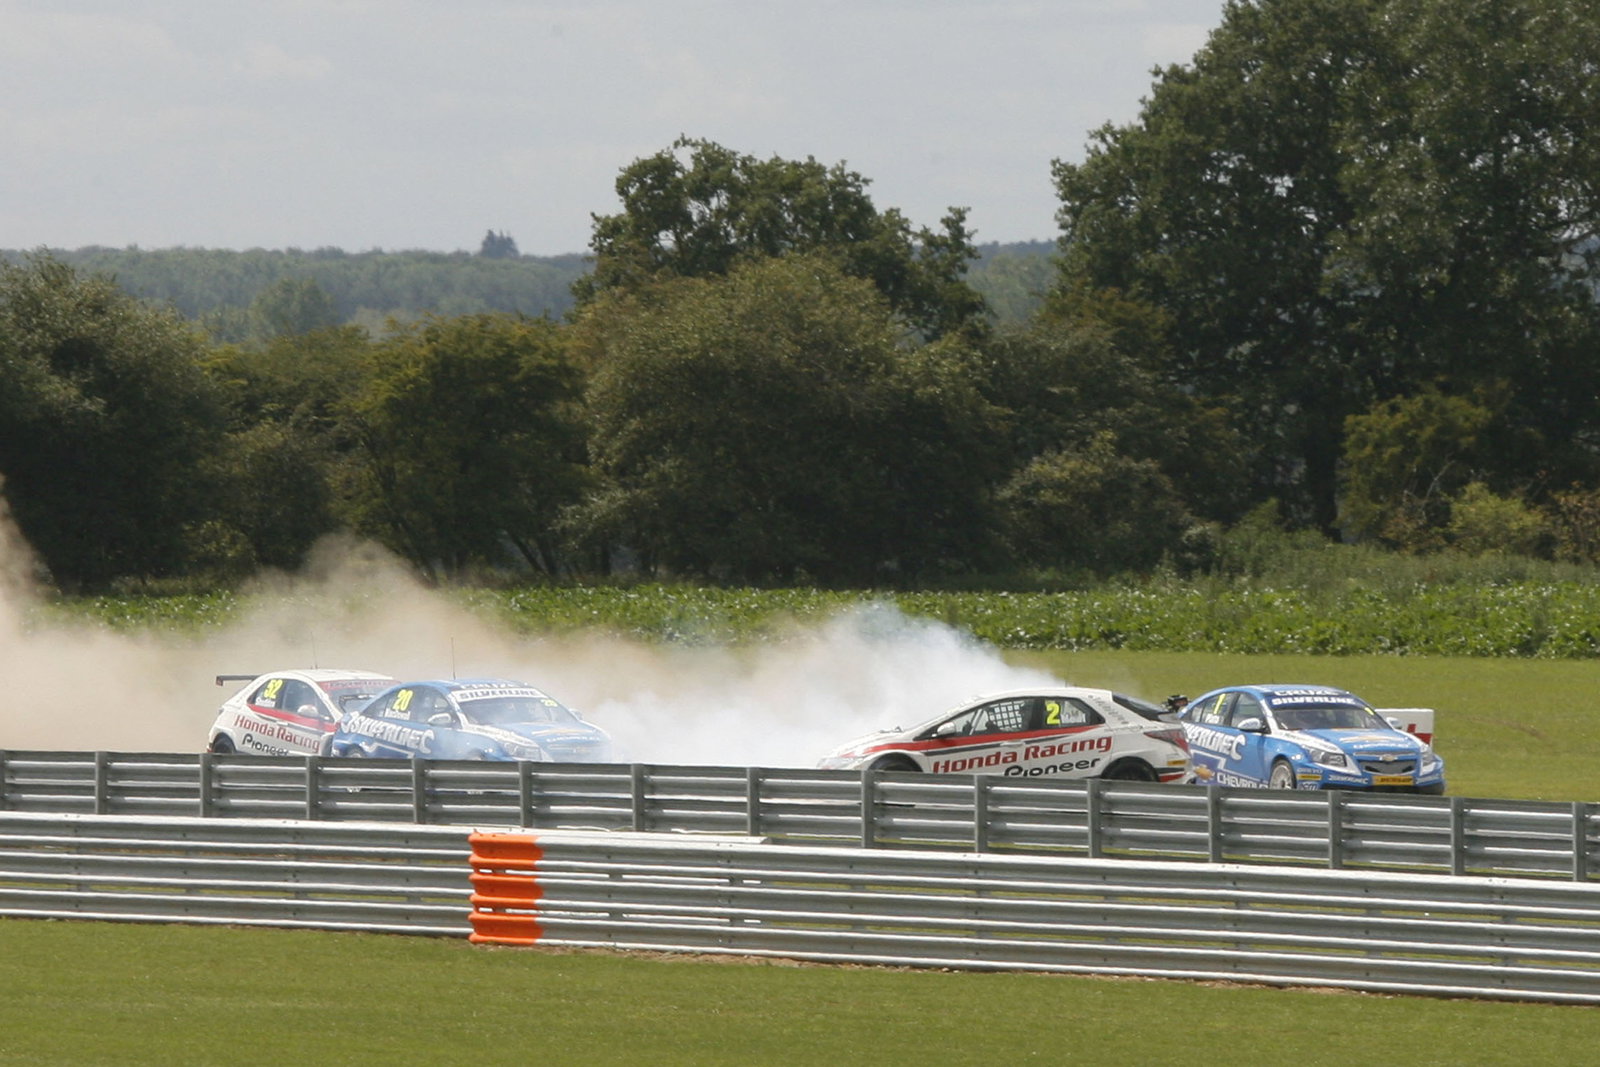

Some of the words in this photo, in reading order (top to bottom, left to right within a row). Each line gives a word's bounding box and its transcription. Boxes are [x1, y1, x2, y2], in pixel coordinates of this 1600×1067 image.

[263, 679, 283, 699] 52
[392, 689, 414, 711] 20
[459, 689, 540, 700] SILVERLINE
[1213, 693, 1226, 715] 1
[1271, 696, 1356, 706] SILVERLINE
[1046, 703, 1061, 725] 2
[234, 714, 276, 737] Honda
[276, 726, 321, 754] Racing
[242, 733, 289, 756] Pioneer
[932, 751, 1017, 774] Honda
[1024, 736, 1112, 761] Racing
[1003, 757, 1101, 777] Pioneer
